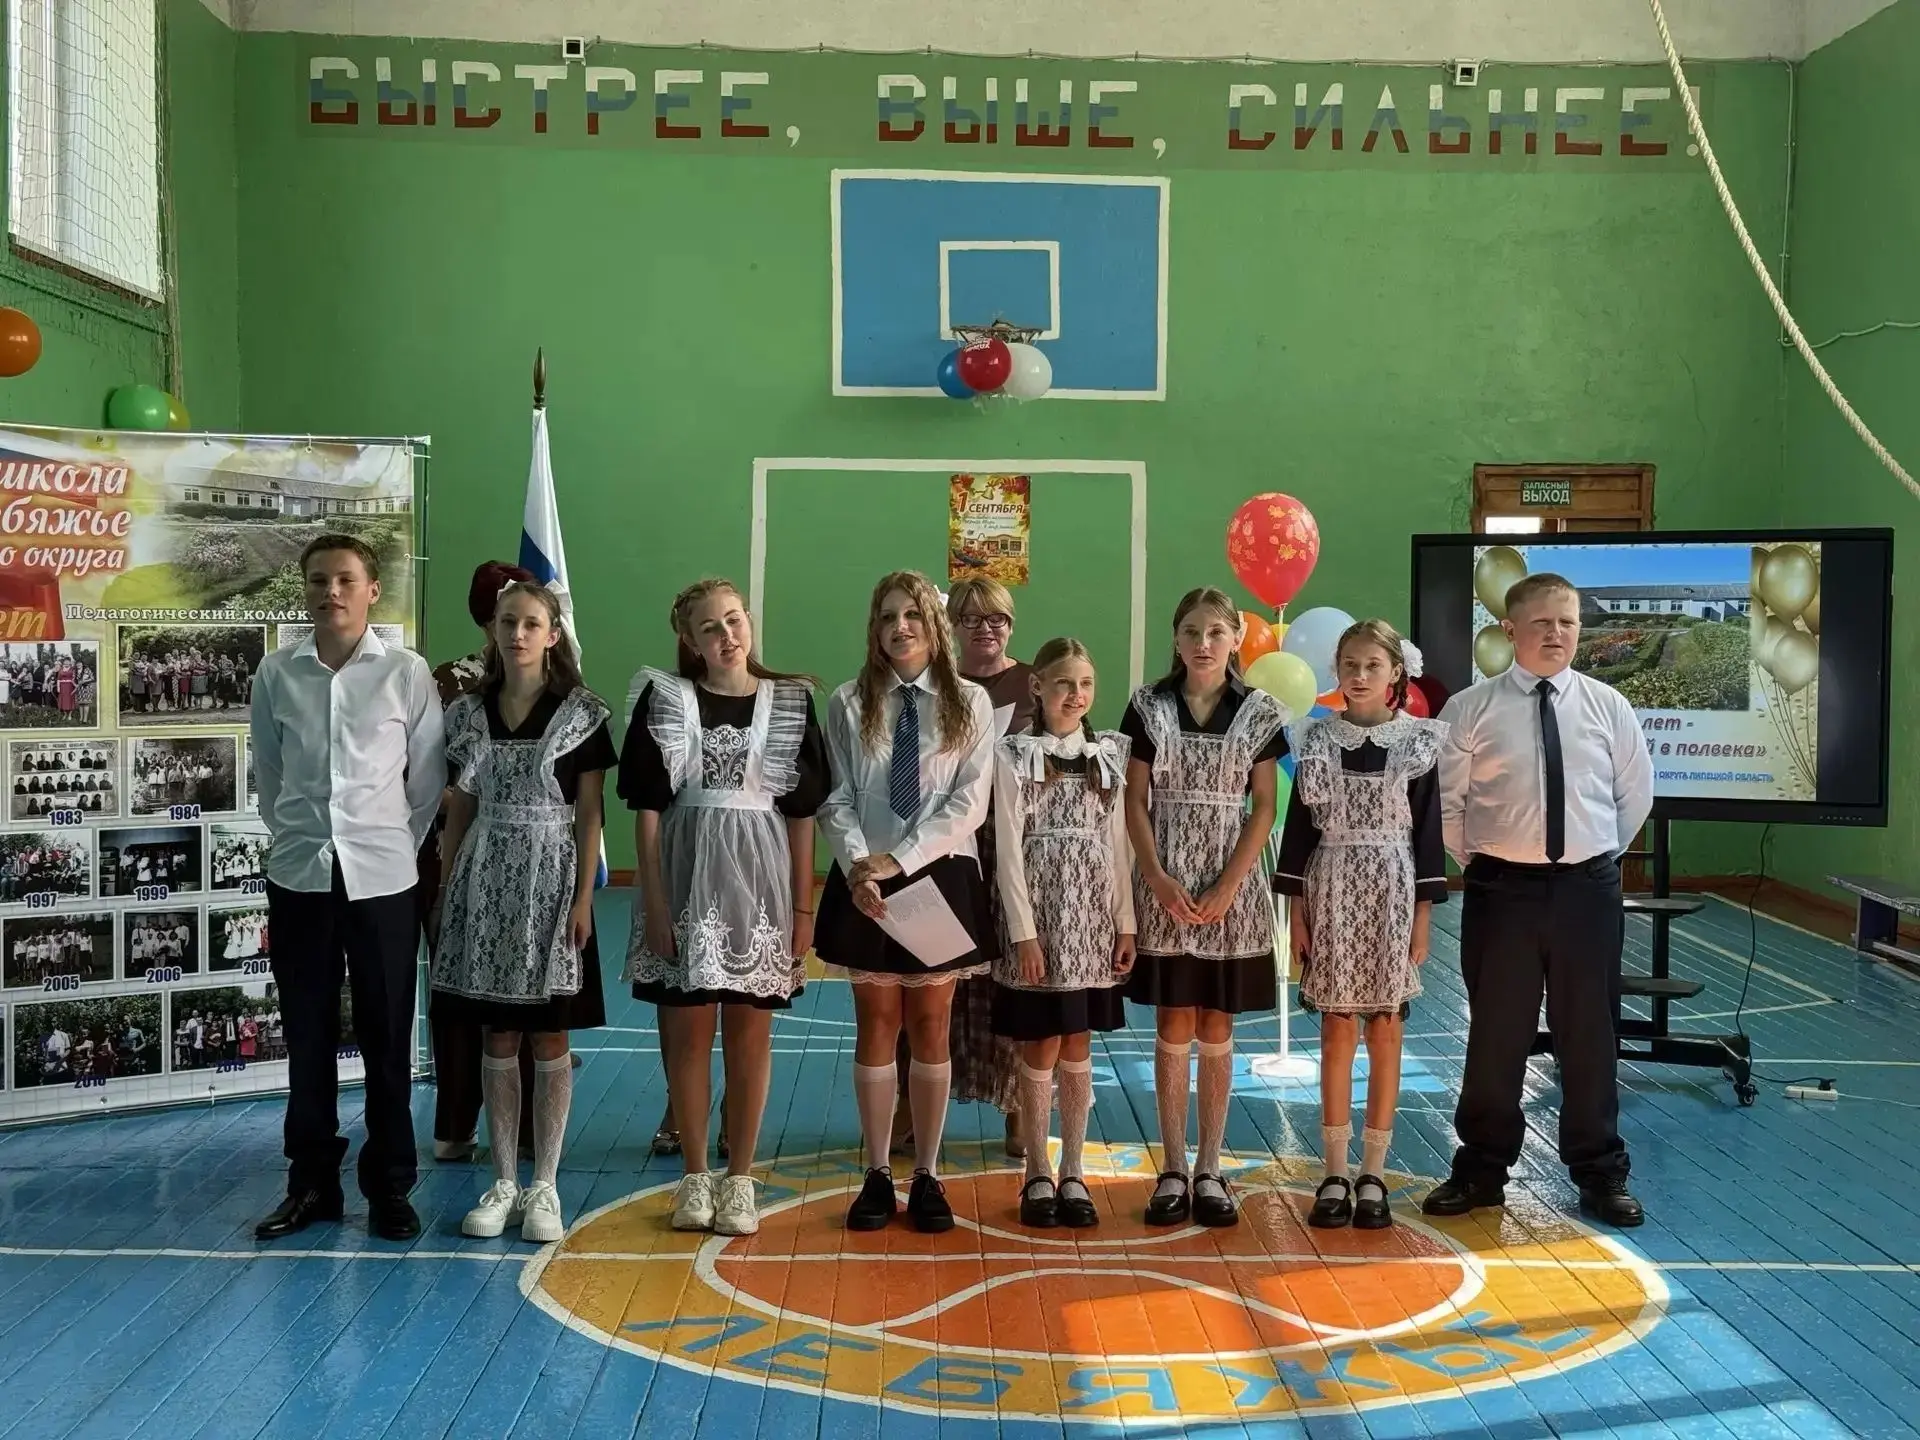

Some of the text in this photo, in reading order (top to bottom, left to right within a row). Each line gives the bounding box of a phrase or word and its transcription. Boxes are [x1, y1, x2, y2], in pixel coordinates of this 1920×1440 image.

[310, 56, 1701, 158] БЫСТРЕЕ, ВЫШЕ, СИЛЬНЕЕ!
[1523, 481, 1570, 489] ЗАПАСНЫЙ
[958, 491, 1023, 513] 1 СЕНТЯБРЯ
[1522, 489, 1570, 504] ВЫХОД
[0, 495, 132, 537] бяжье
[24, 546, 125, 577] округа
[66, 604, 235, 621] Педагогический
[1642, 717, 1681, 731] лет
[1660, 743, 1671, 756] в
[1676, 743, 1767, 757] полвека»
[49, 811, 83, 826] 1983
[168, 805, 201, 821] 1984
[134, 886, 169, 902] 1999
[241, 880, 267, 895] 200
[25, 892, 58, 909] 1997
[43, 975, 80, 992] 2005
[146, 967, 182, 984] 2006
[337, 1045, 361, 1060] 202
